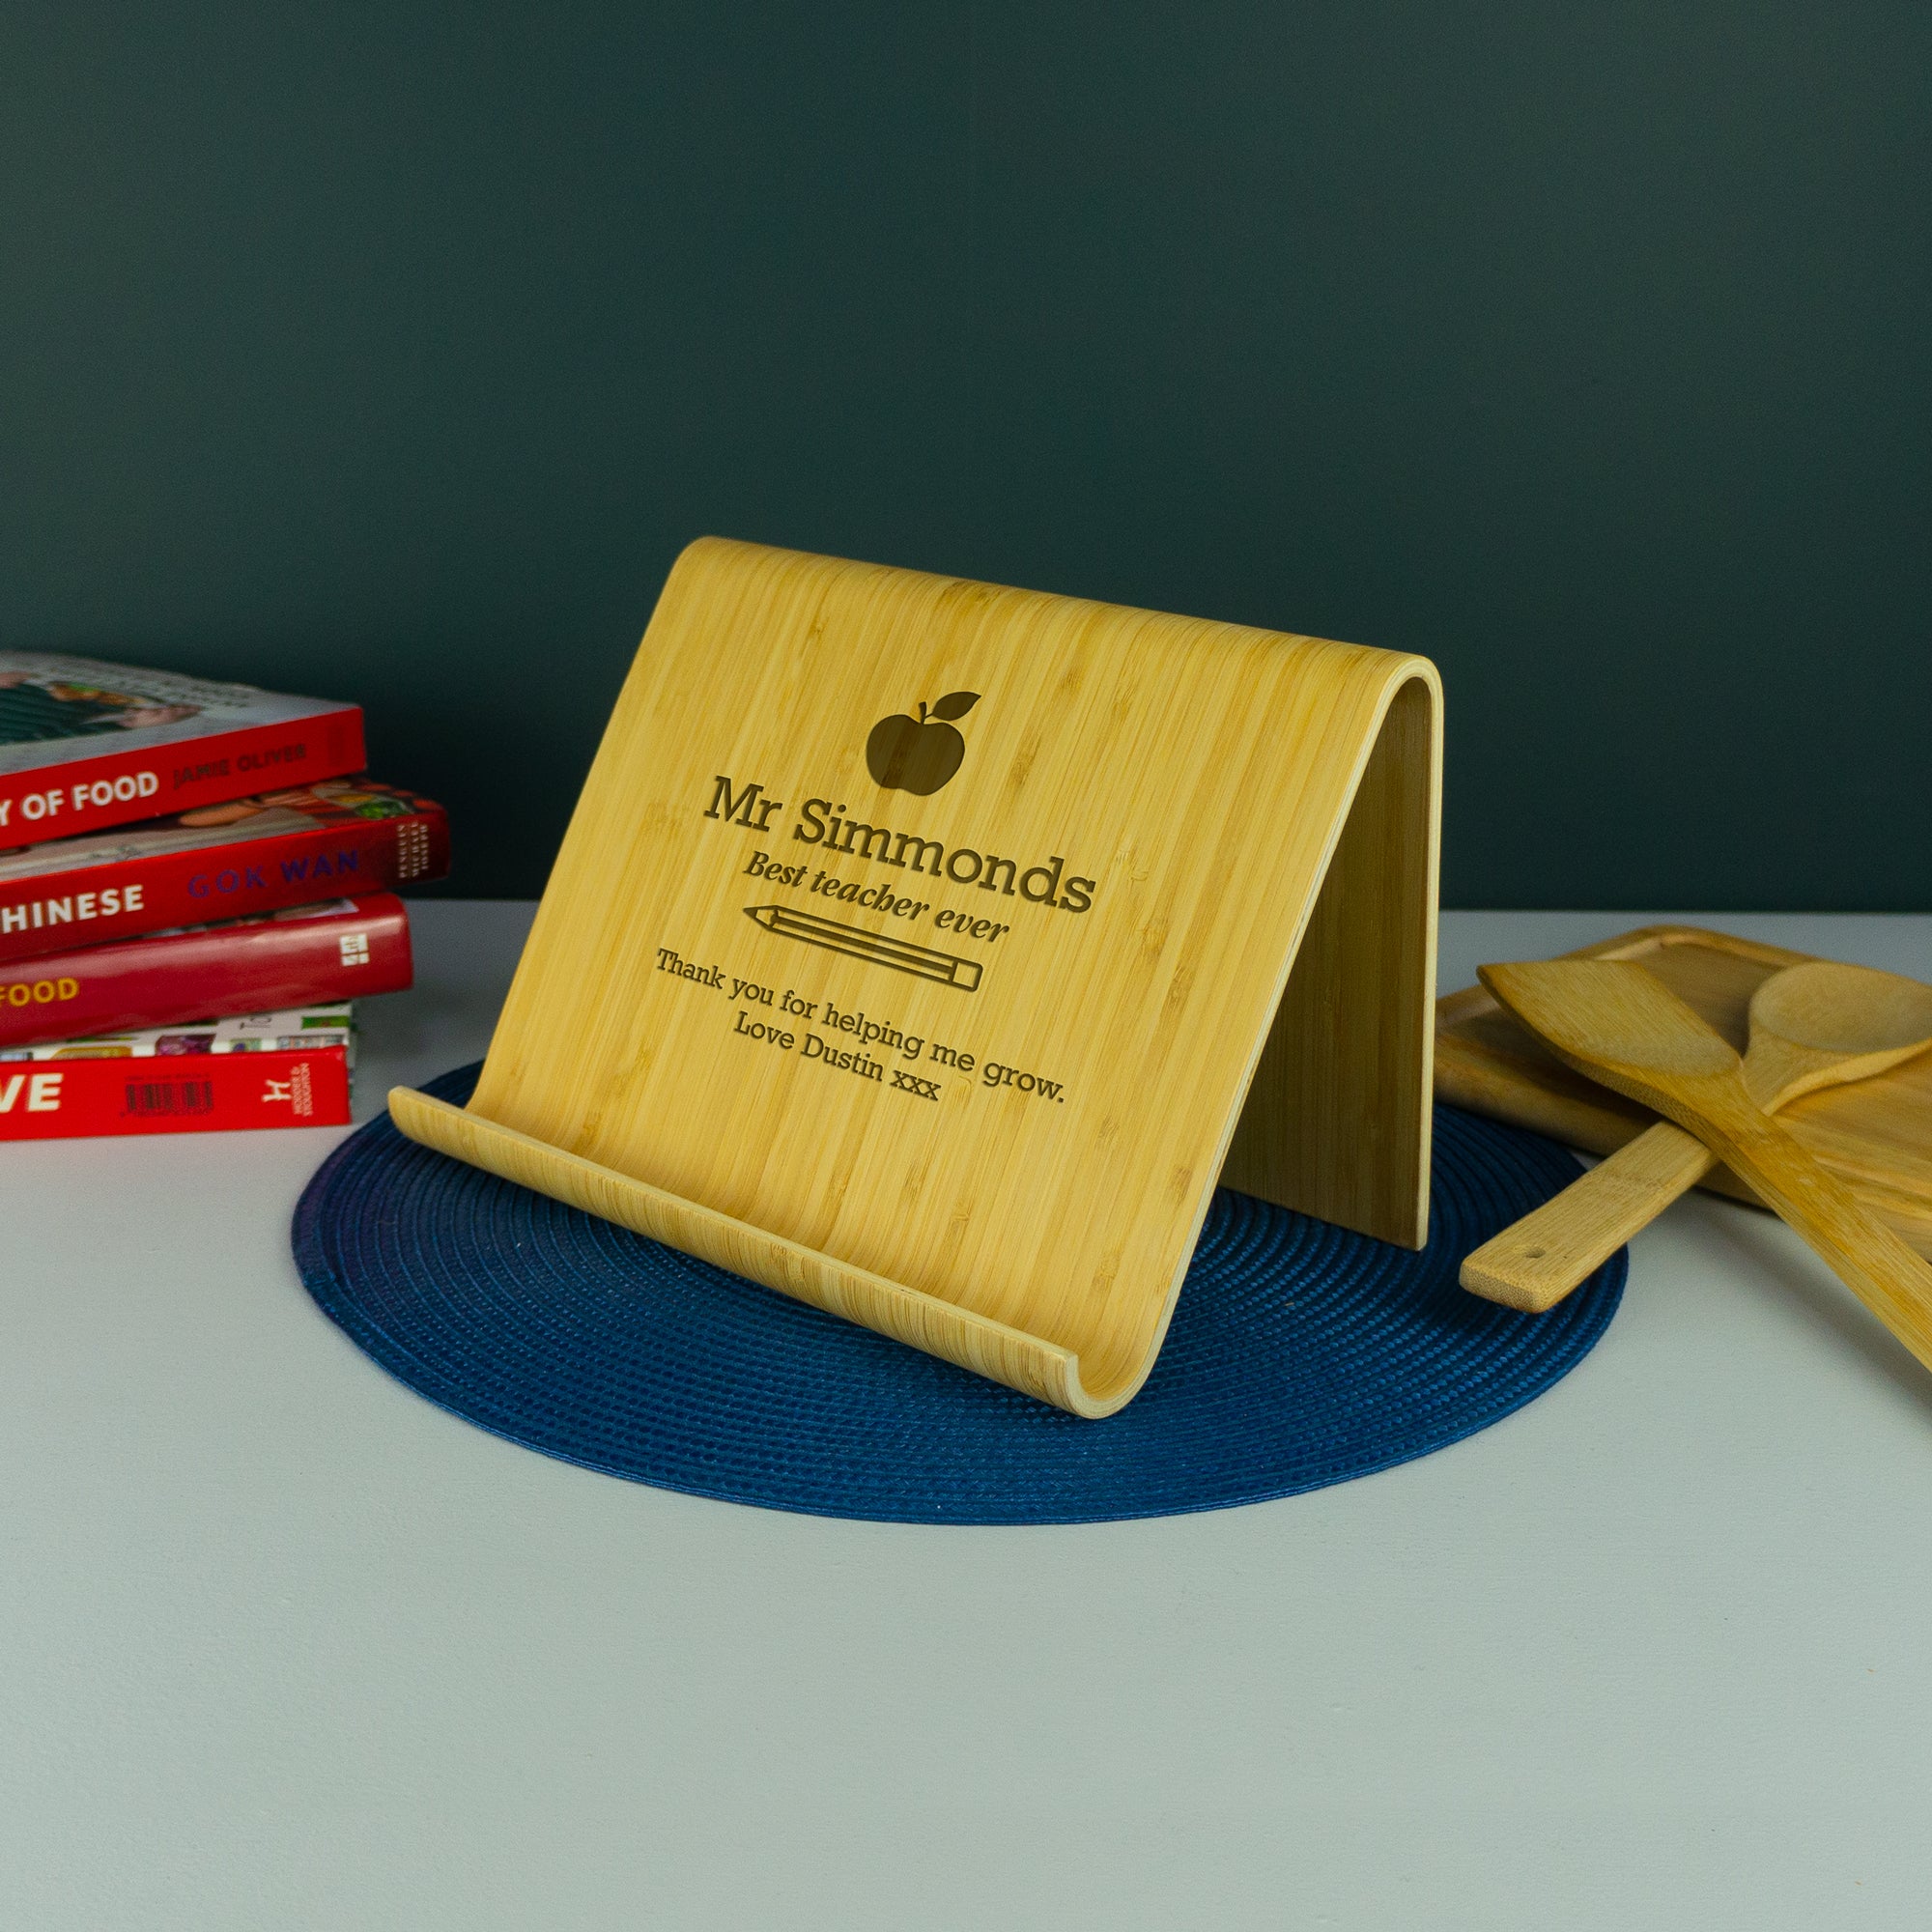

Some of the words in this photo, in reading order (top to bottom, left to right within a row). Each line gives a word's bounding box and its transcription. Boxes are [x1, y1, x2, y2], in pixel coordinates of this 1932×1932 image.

[21, 788, 64, 820] OF
[71, 771, 159, 811] FOOD
[173, 759, 231, 790] JAMIE
[236, 743, 306, 772] OLIVER
[187, 865, 269, 899] GOK
[280, 849, 358, 883] WAN
[703, 775, 782, 833] Mr
[793, 798, 1096, 914] Simmonds
[1, 884, 144, 934] HINESE
[743, 850, 809, 888] Best
[810, 870, 930, 922] teacher
[934, 909, 1010, 944] ever
[657, 948, 726, 990] Thank
[727, 978, 775, 1007] you
[779, 989, 818, 1020] for
[821, 1002, 925, 1061] helping
[929, 1043, 976, 1072] me
[982, 1062, 1065, 1103] grow.
[733, 1010, 795, 1050] Love
[800, 1033, 884, 1083] Dustin
[890, 1069, 942, 1102] xxx
